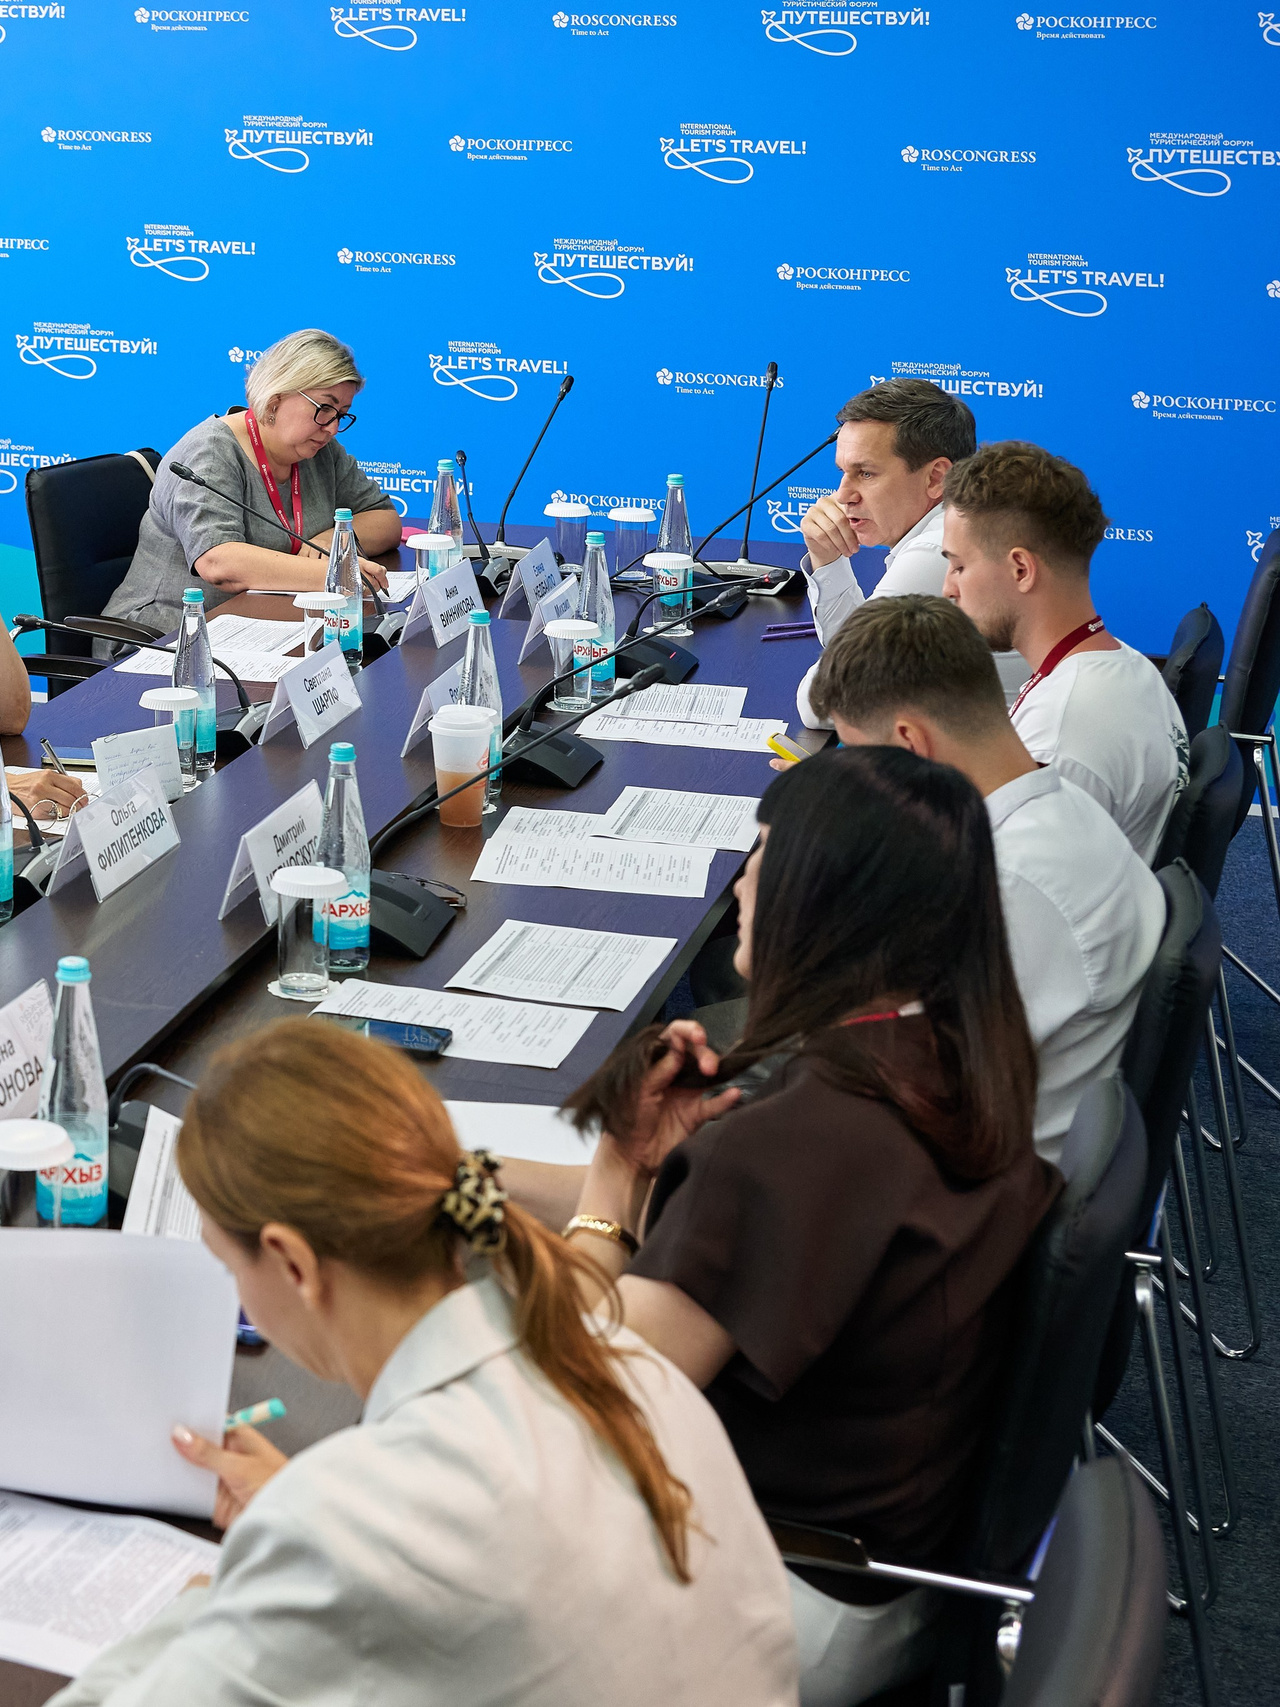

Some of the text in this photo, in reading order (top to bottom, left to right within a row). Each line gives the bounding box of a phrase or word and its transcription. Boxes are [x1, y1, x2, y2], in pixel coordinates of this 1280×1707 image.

[151, 10, 249, 23] РОСКОНГРЕСС
[349, 8, 466, 22] LET'S TRAVEL!
[570, 14, 677, 27] ROSCONGRESS
[781, 8, 930, 26] ПУТЕШЕСТВУЙ!
[1036, 16, 1157, 29] РОСКОНГРЕСС
[1036, 31, 1059, 41] Время
[57, 130, 152, 143] ROSCONGRESS
[242, 128, 373, 146] ПУТЕШЕСТВУЙ!
[1150, 132, 1224, 141] МЕЖДУНАРОДНЫЙ
[1150, 138, 1254, 147] ТУРИСТИЧЕСКИЙ ФОРУМ
[467, 138, 572, 152] РОСКОНГРЕСС
[680, 138, 806, 155] LET'S TRAVEL!
[921, 149, 1036, 163] ROSCONGRESS
[144, 238, 255, 255] LET'S TRAVEL!
[355, 251, 456, 266] ROSCONGRESS
[553, 253, 694, 272] ПУТЕШЕСТВУЙ!
[1028, 253, 1084, 261] INTERNATIONAL
[1028, 259, 1060, 267] TOURISM
[796, 267, 910, 282] РОСКОНГРЕСС
[1027, 269, 1165, 288] LET'S TRAVEL!
[796, 281, 861, 291] Время действовать
[33, 336, 157, 355] ПУТЕШЕСТВУЙ!
[448, 340, 497, 349] INTERNATIONAL
[449, 346, 477, 354] TOURISM
[448, 355, 568, 375] LET'S TRAVEL!
[891, 361, 961, 370] МЕЖДУНАРОДНЫЙ
[891, 367, 990, 378] ТУРИСТИЧЕСКИЙ ФОРУМ
[675, 386, 693, 395] Time
[702, 388, 715, 396] Act
[1152, 395, 1276, 413] РОСКОНГРЕСС
[1152, 410, 1223, 421] Время действовать
[570, 494, 667, 511] РОСКОНГРЕС
[440, 595, 477, 628] ВИННИКОВА
[312, 687, 340, 717] ШАРПФ
[111, 800, 138, 827] Ольга
[97, 807, 168, 872] ФИЛИПЕНКОВА
[273, 815, 307, 858] Дмитрий
